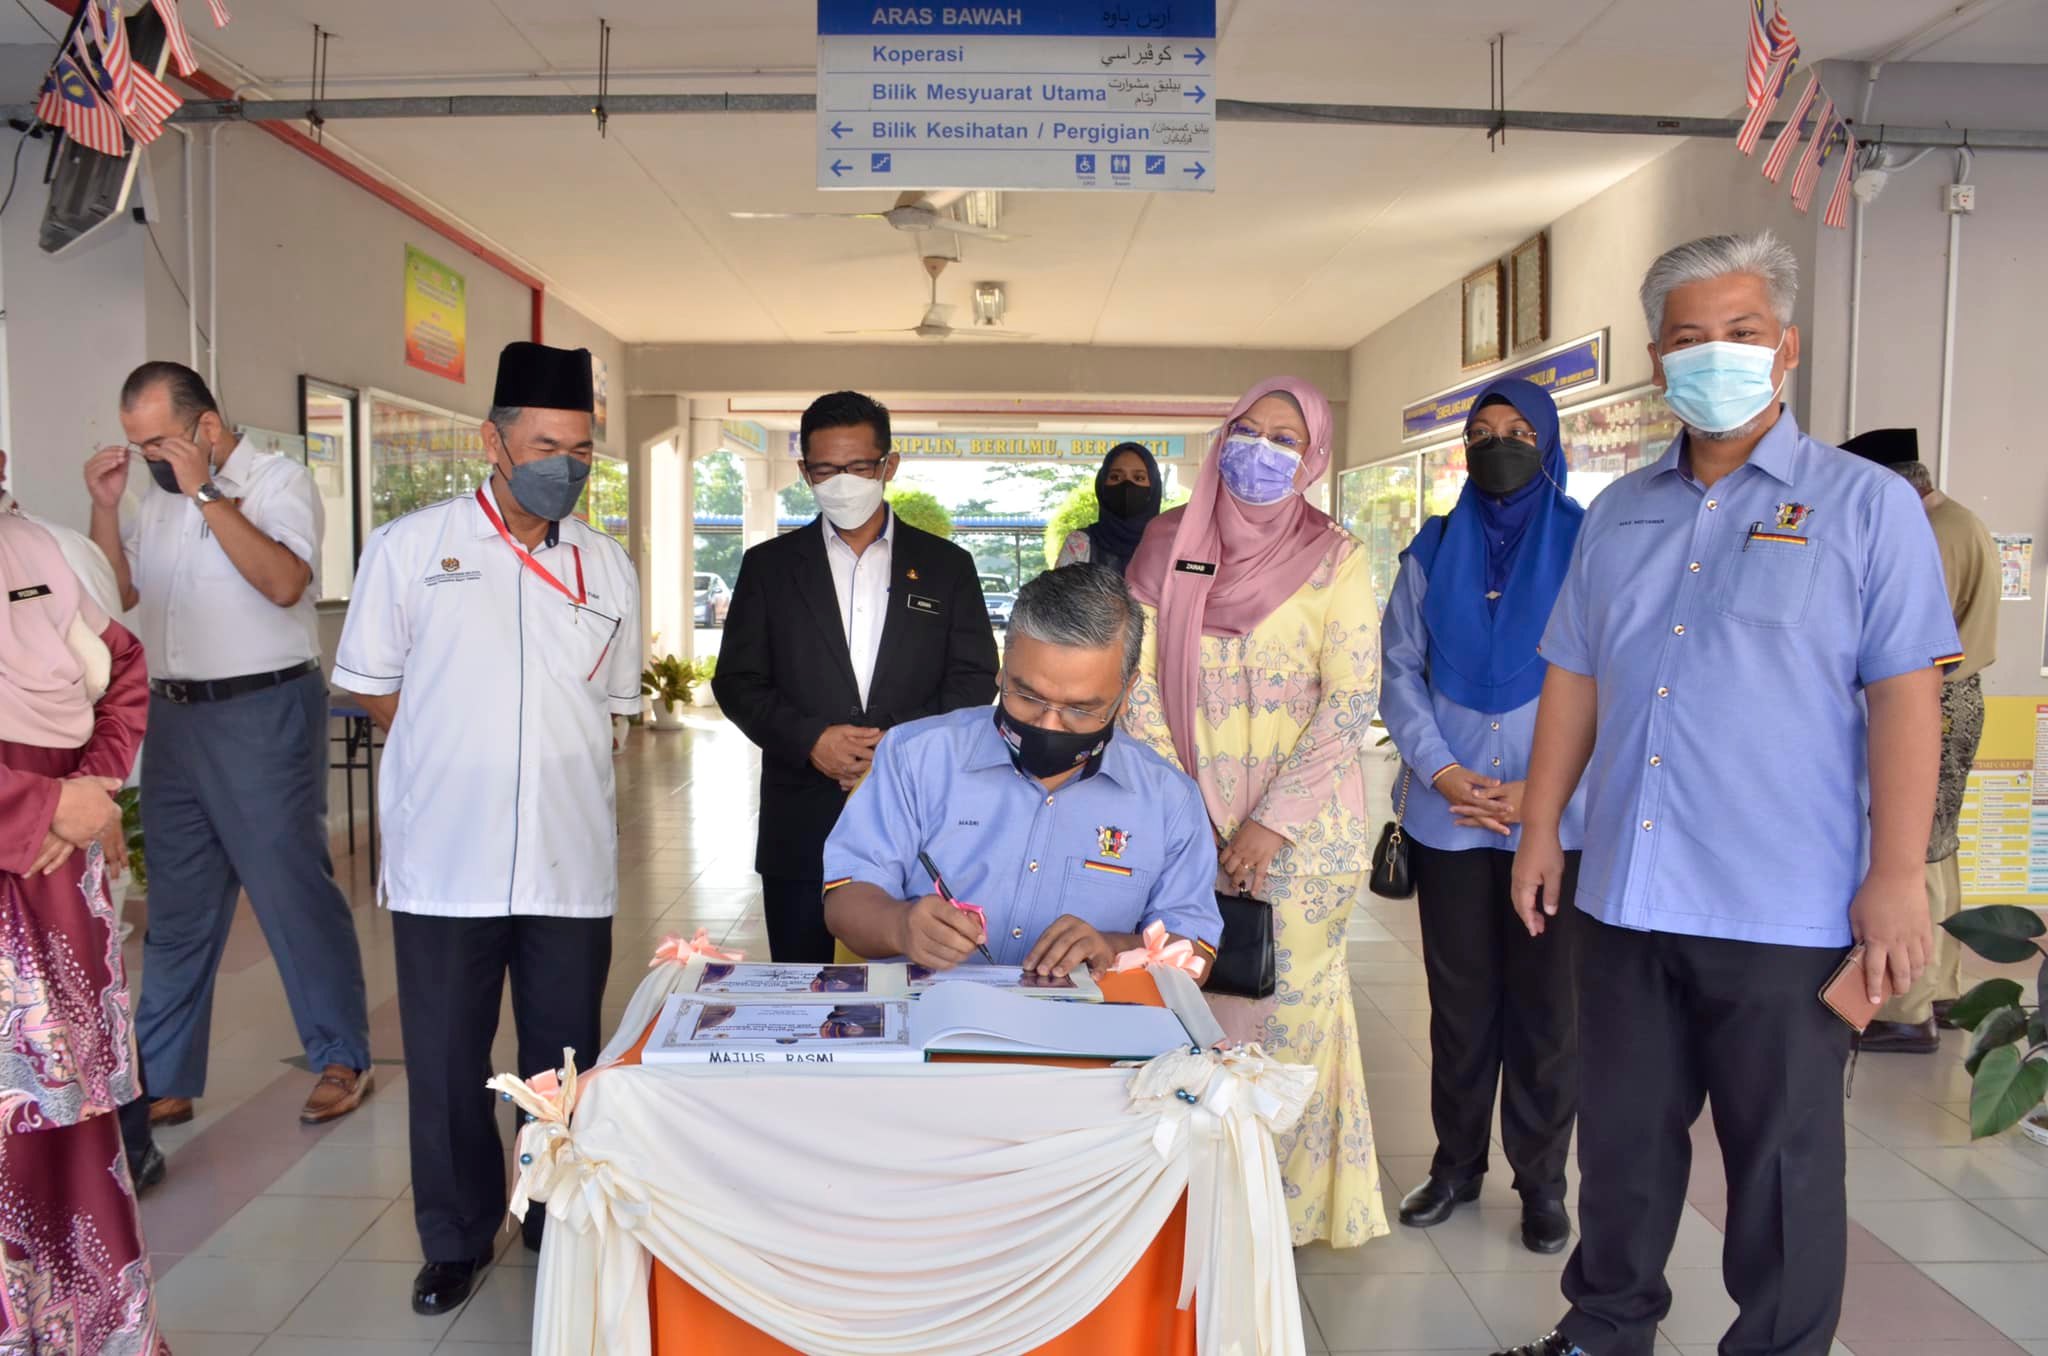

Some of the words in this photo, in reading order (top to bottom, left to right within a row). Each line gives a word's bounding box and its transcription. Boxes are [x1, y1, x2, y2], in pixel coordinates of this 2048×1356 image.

[872, 8, 933, 25] ARAS
[942, 8, 1022, 25] BAWAH
[872, 46, 964, 65] Koperasi
[872, 84, 917, 101] Bilik
[926, 85, 1033, 105] Mesyuarat
[1042, 86, 1106, 102] Utama
[872, 122, 917, 139] Bilik
[926, 123, 1029, 140] Kesihatan
[1037, 123, 1044, 140] /
[1053, 124, 1150, 144] Pergigian
[891, 439, 963, 459] SIPLIN,
[969, 439, 1064, 459] BERILMU,
[1070, 440, 1169, 457] BERKTI
[708, 1051, 766, 1064] MAJLIS
[785, 1052, 834, 1064] RASMI
